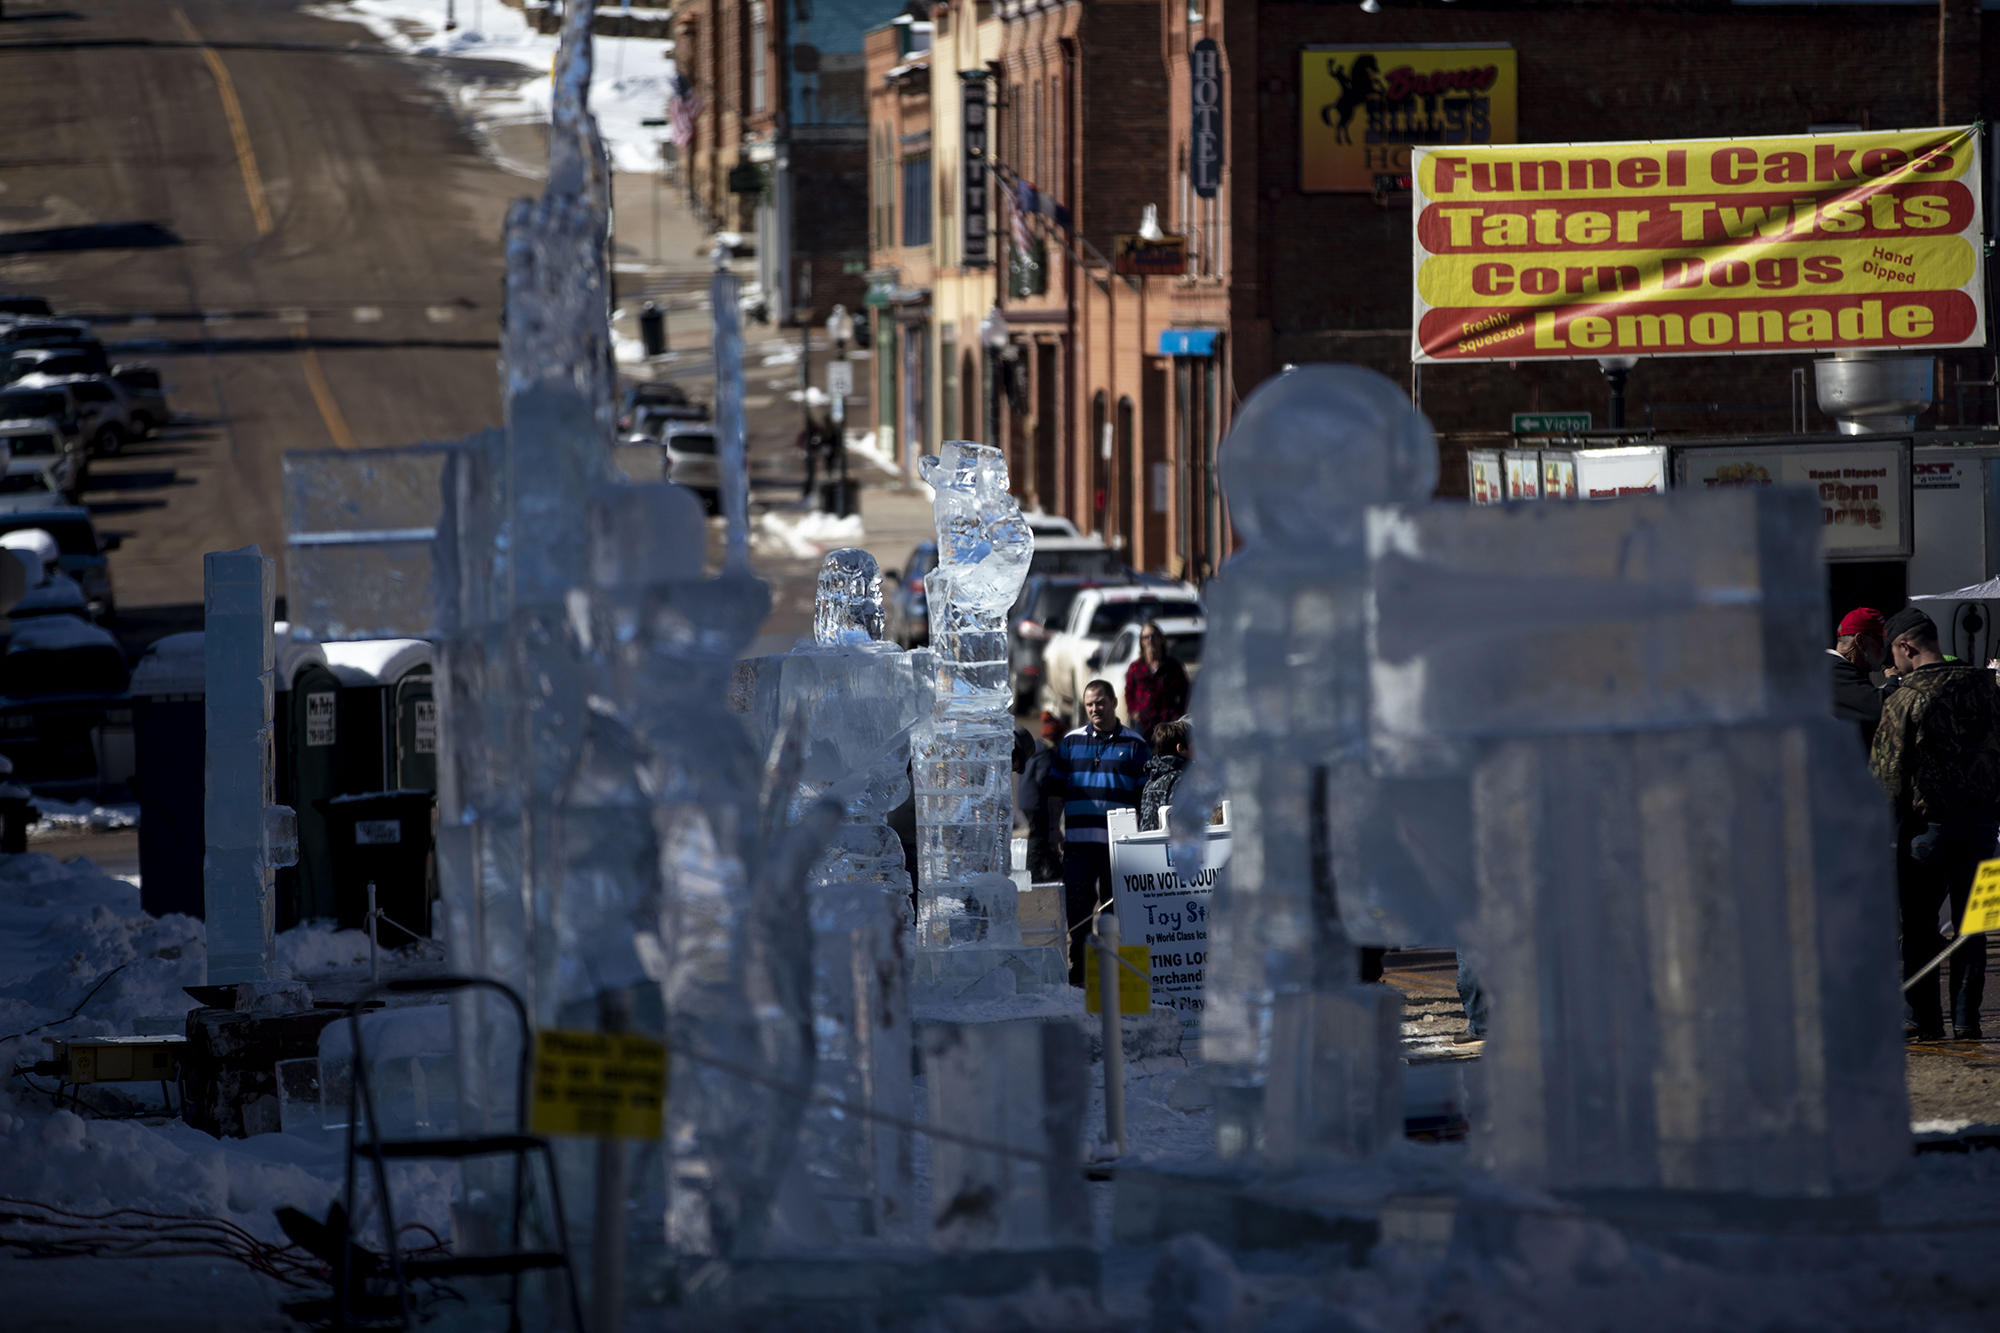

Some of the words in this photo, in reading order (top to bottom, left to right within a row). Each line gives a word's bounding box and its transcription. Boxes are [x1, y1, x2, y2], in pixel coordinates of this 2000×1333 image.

[1193, 50, 1219, 189] HOTEL
[1365, 147, 1411, 170] HO
[1435, 150, 1687, 193] Funnel
[1711, 144, 1955, 185] Cakes
[1439, 208, 1651, 247] Tater
[1669, 193, 1951, 240] Twists
[1872, 246, 1914, 266] Hand
[1472, 262, 1641, 296] Corn
[1662, 256, 1844, 290] Dogs
[1863, 261, 1916, 285] Dipped
[1462, 312, 1510, 335] Freshly
[1534, 300, 1935, 349] Lemonade
[1458, 322, 1525, 354] Squeezed
[1543, 416, 1589, 431] Victor
[1809, 469, 1840, 479] Hand
[1843, 468, 1886, 479] Dipped
[1819, 483, 1878, 501] Corn
[1123, 873, 1155, 892] YOUR
[1189, 867, 1224, 888] COUN
[1143, 904, 1181, 931] Toy
[1186, 901, 1211, 923] St
[1146, 934, 1154, 945] By
[1156, 932, 1175, 943] World
[1176, 931, 1195, 941] Class
[1196, 930, 1207, 939] Ice
[1151, 953, 1182, 968] TING
